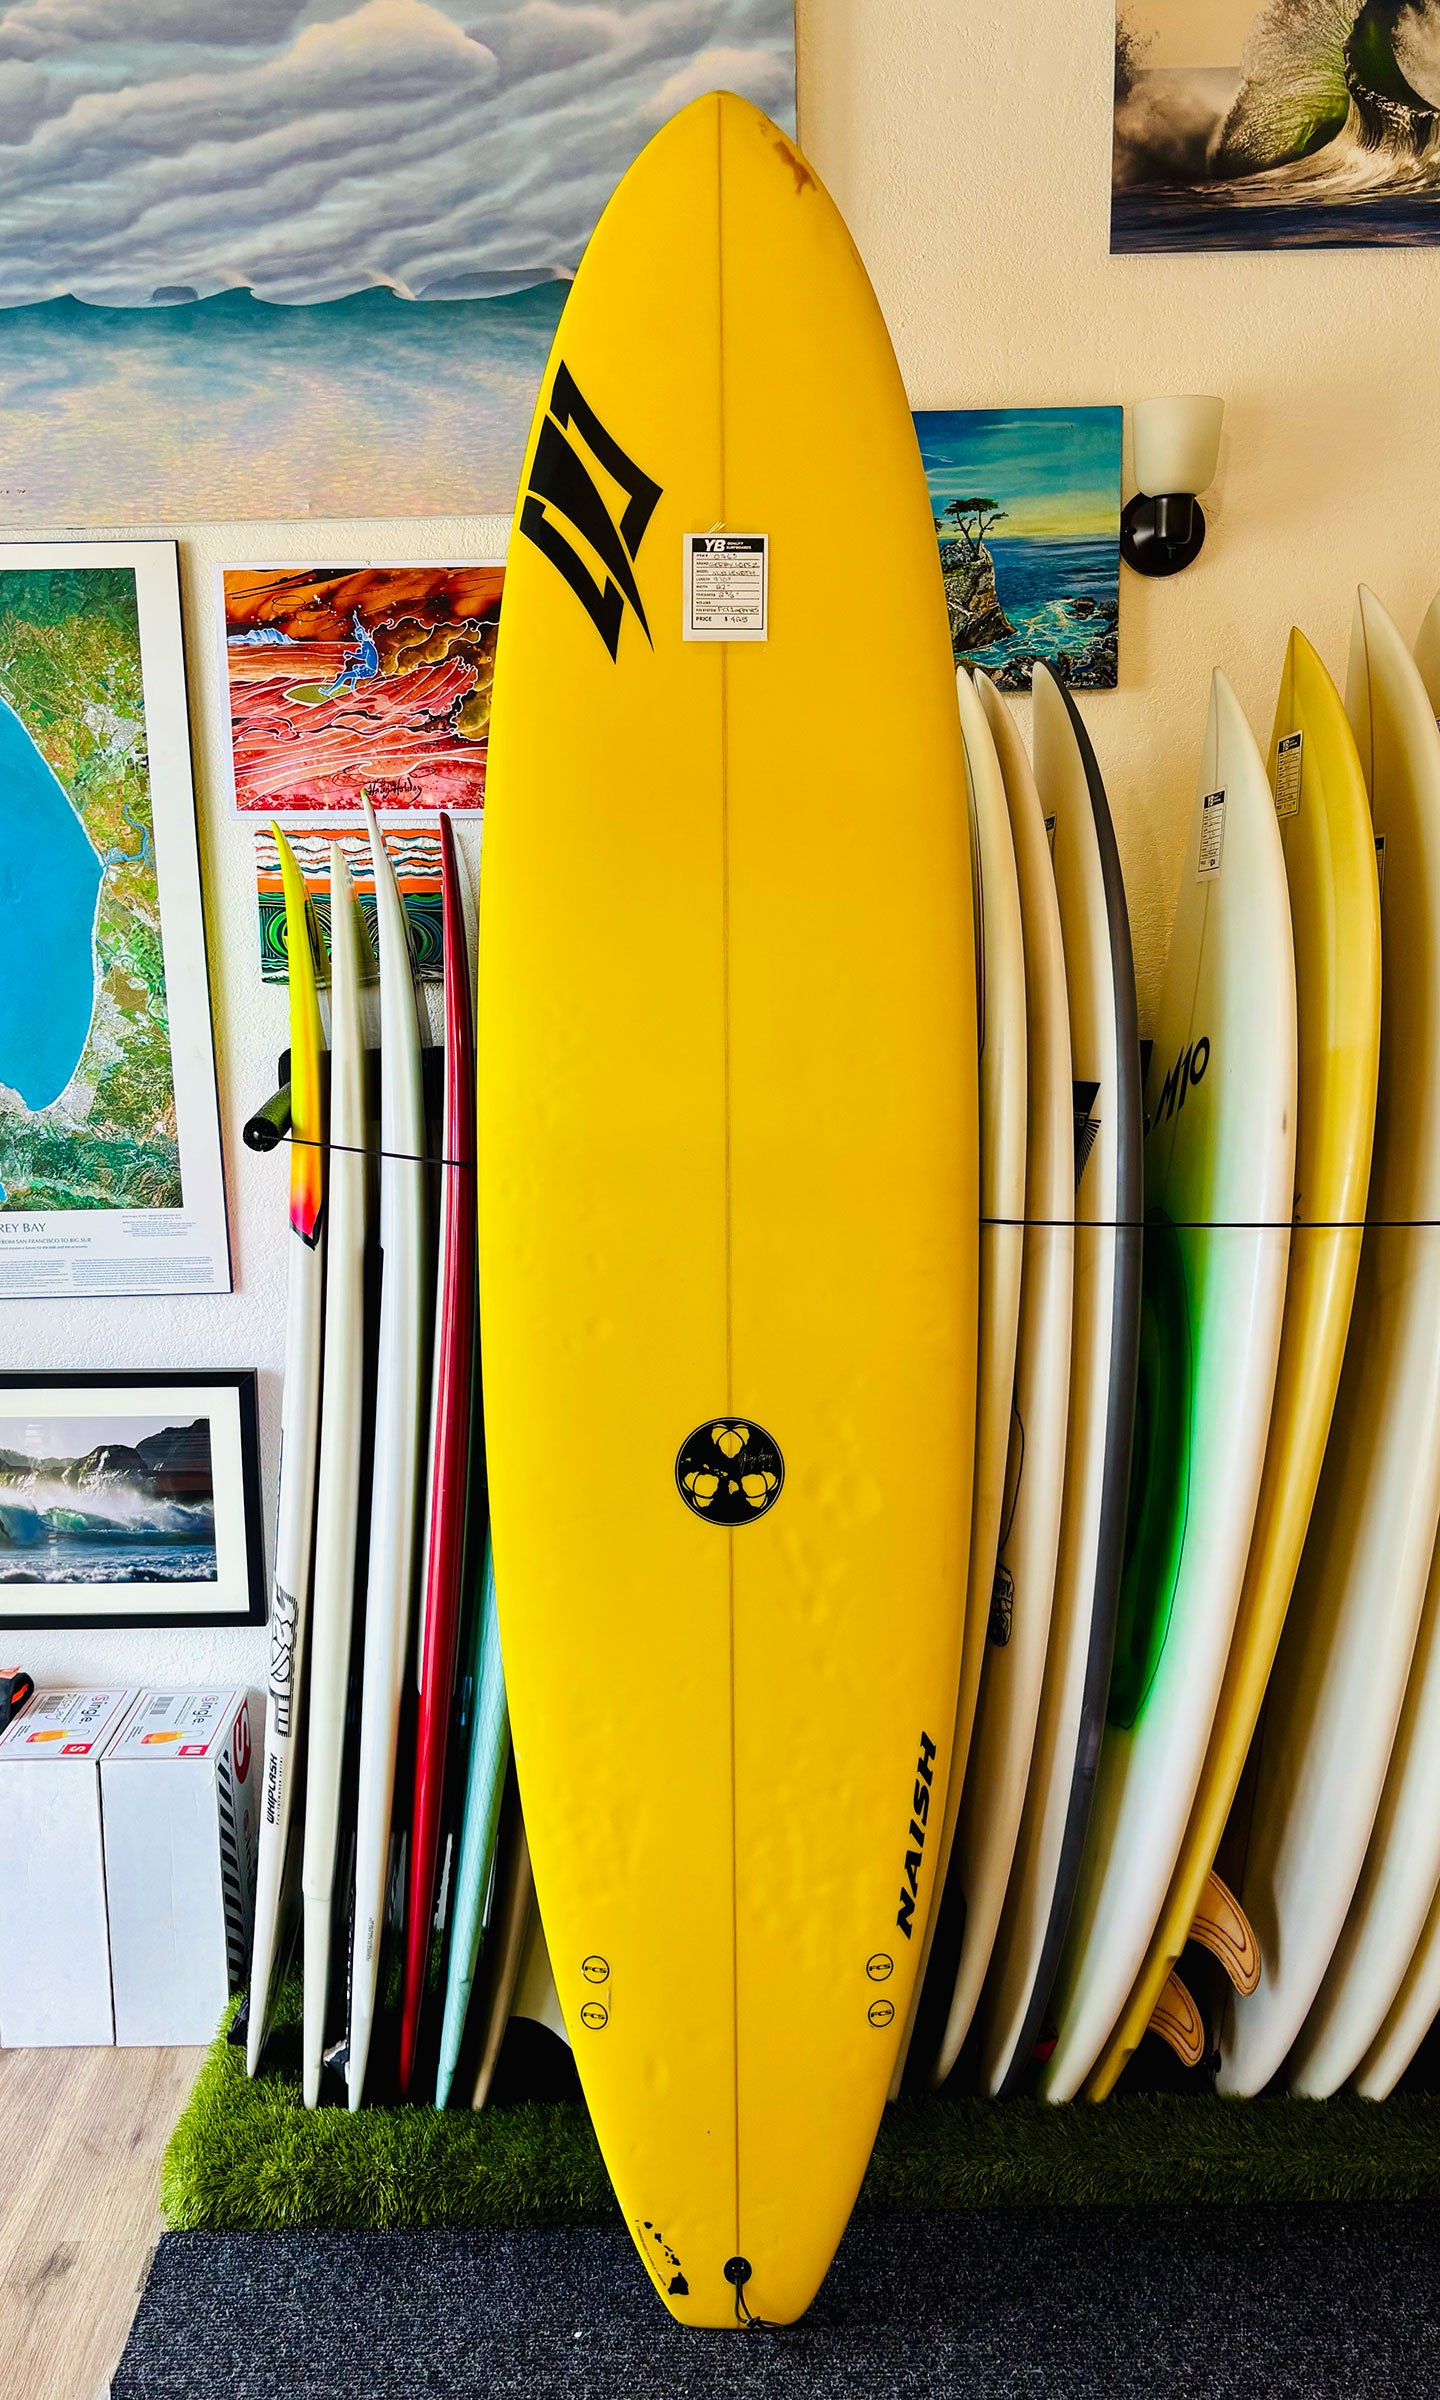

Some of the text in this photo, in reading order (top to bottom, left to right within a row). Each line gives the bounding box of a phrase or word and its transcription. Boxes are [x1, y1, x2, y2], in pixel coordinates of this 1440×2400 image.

[704, 539, 726, 552] YB
[23, 1222, 46, 1233] BAY
[69, 1745, 87, 1753] S
[266, 1751, 278, 1825] WHIPLASH
[896, 1730, 936, 1941] NAISH
[585, 1966, 607, 1974] FCS
[868, 1962, 891, 1972] FCS
[583, 2012, 605, 2020] FCS
[870, 2008, 892, 2018] FCS
